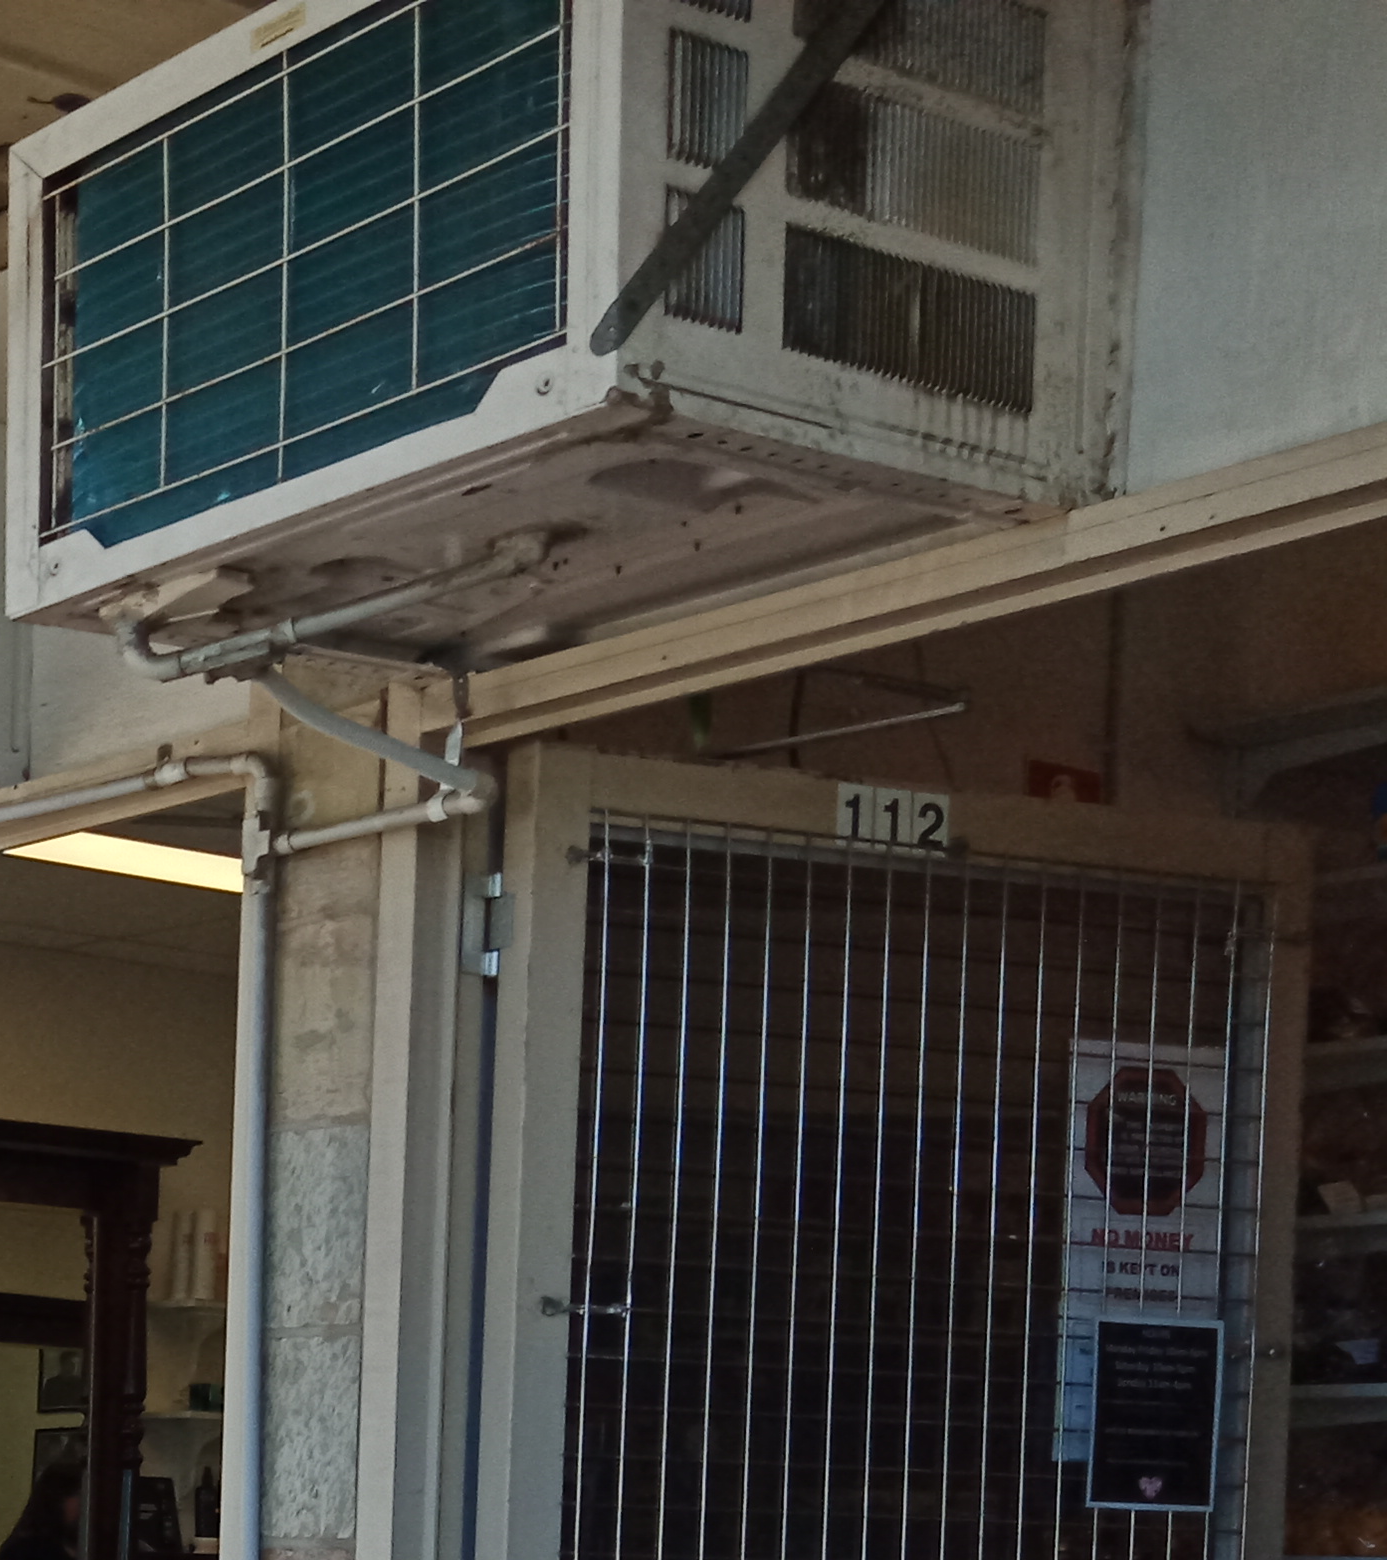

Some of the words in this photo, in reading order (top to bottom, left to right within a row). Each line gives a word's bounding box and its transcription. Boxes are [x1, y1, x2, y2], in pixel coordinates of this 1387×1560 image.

[845, 793, 945, 851] 112
[1092, 1227, 1120, 1249] NO
[1124, 1229, 1194, 1252] MONEY
